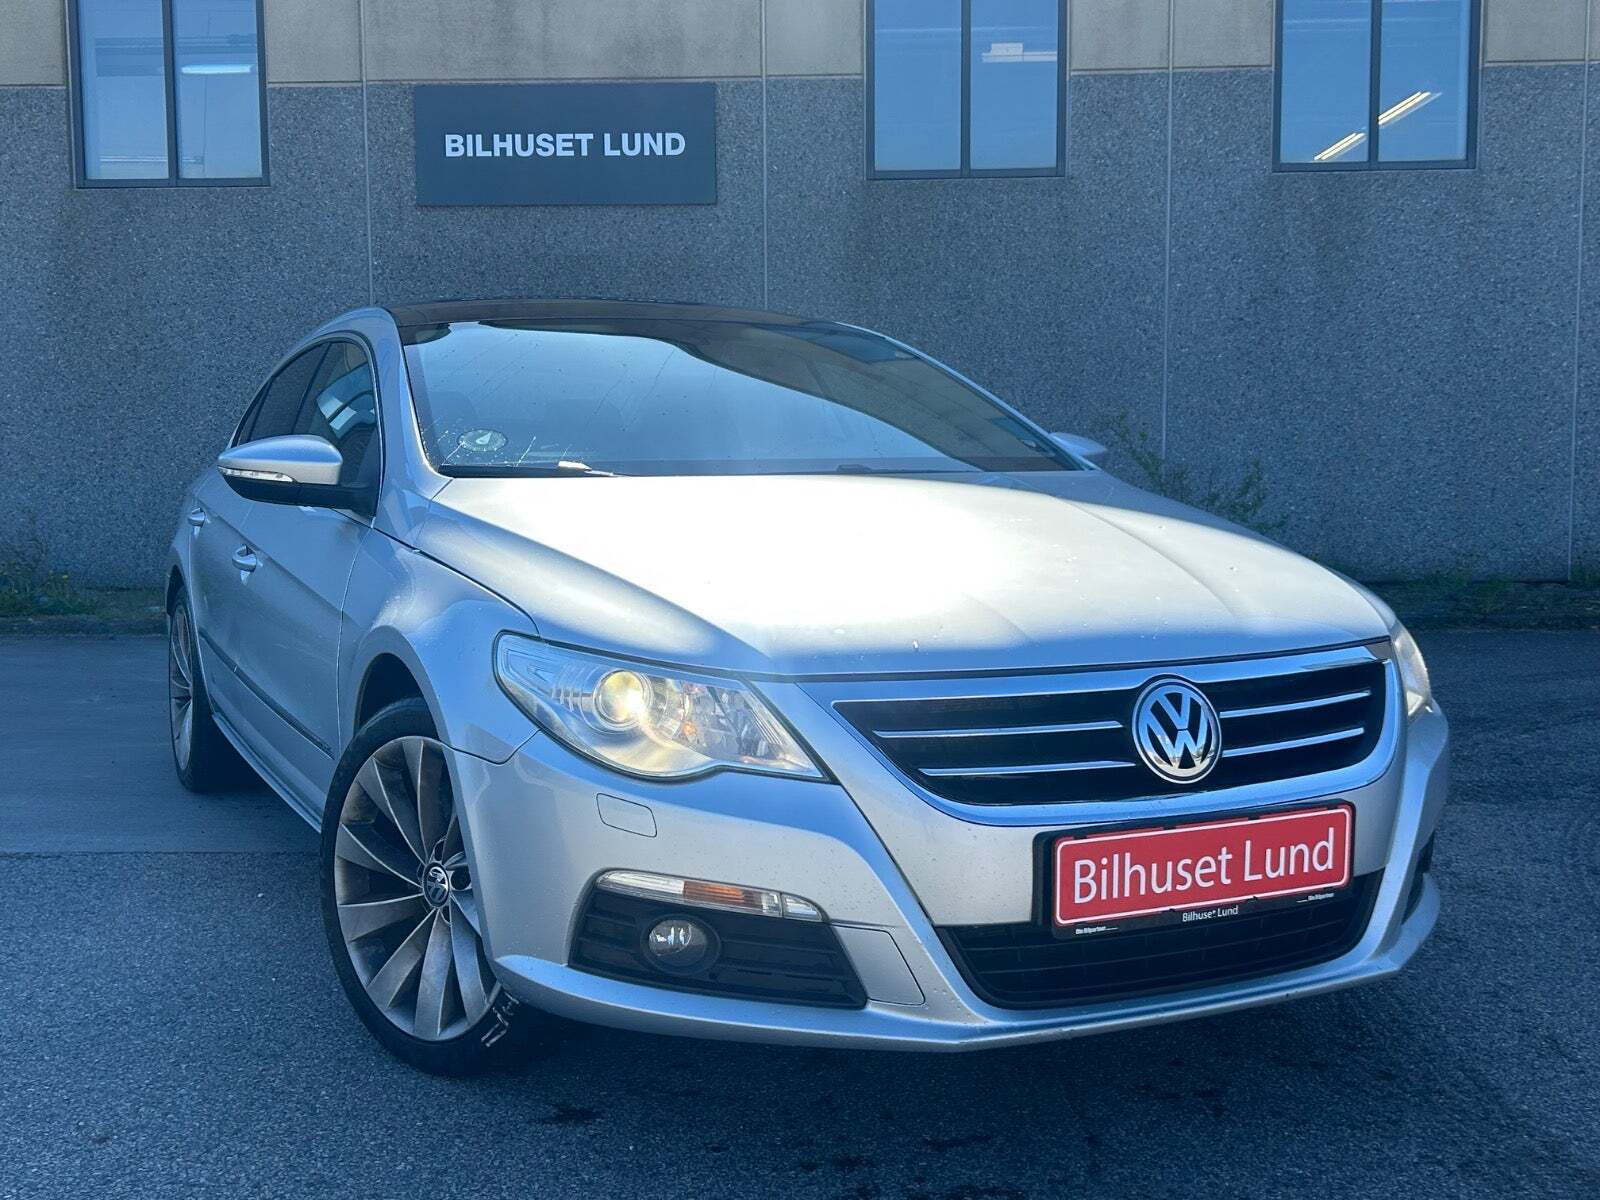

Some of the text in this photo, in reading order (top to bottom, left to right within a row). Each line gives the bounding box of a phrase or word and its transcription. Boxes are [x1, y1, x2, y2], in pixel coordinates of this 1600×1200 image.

[445, 132, 686, 157] BILHUSET LUND
[1136, 682, 1217, 780] VW
[1073, 826, 1335, 904] Bilhuset Lund
[1217, 904, 1239, 917] Lund
